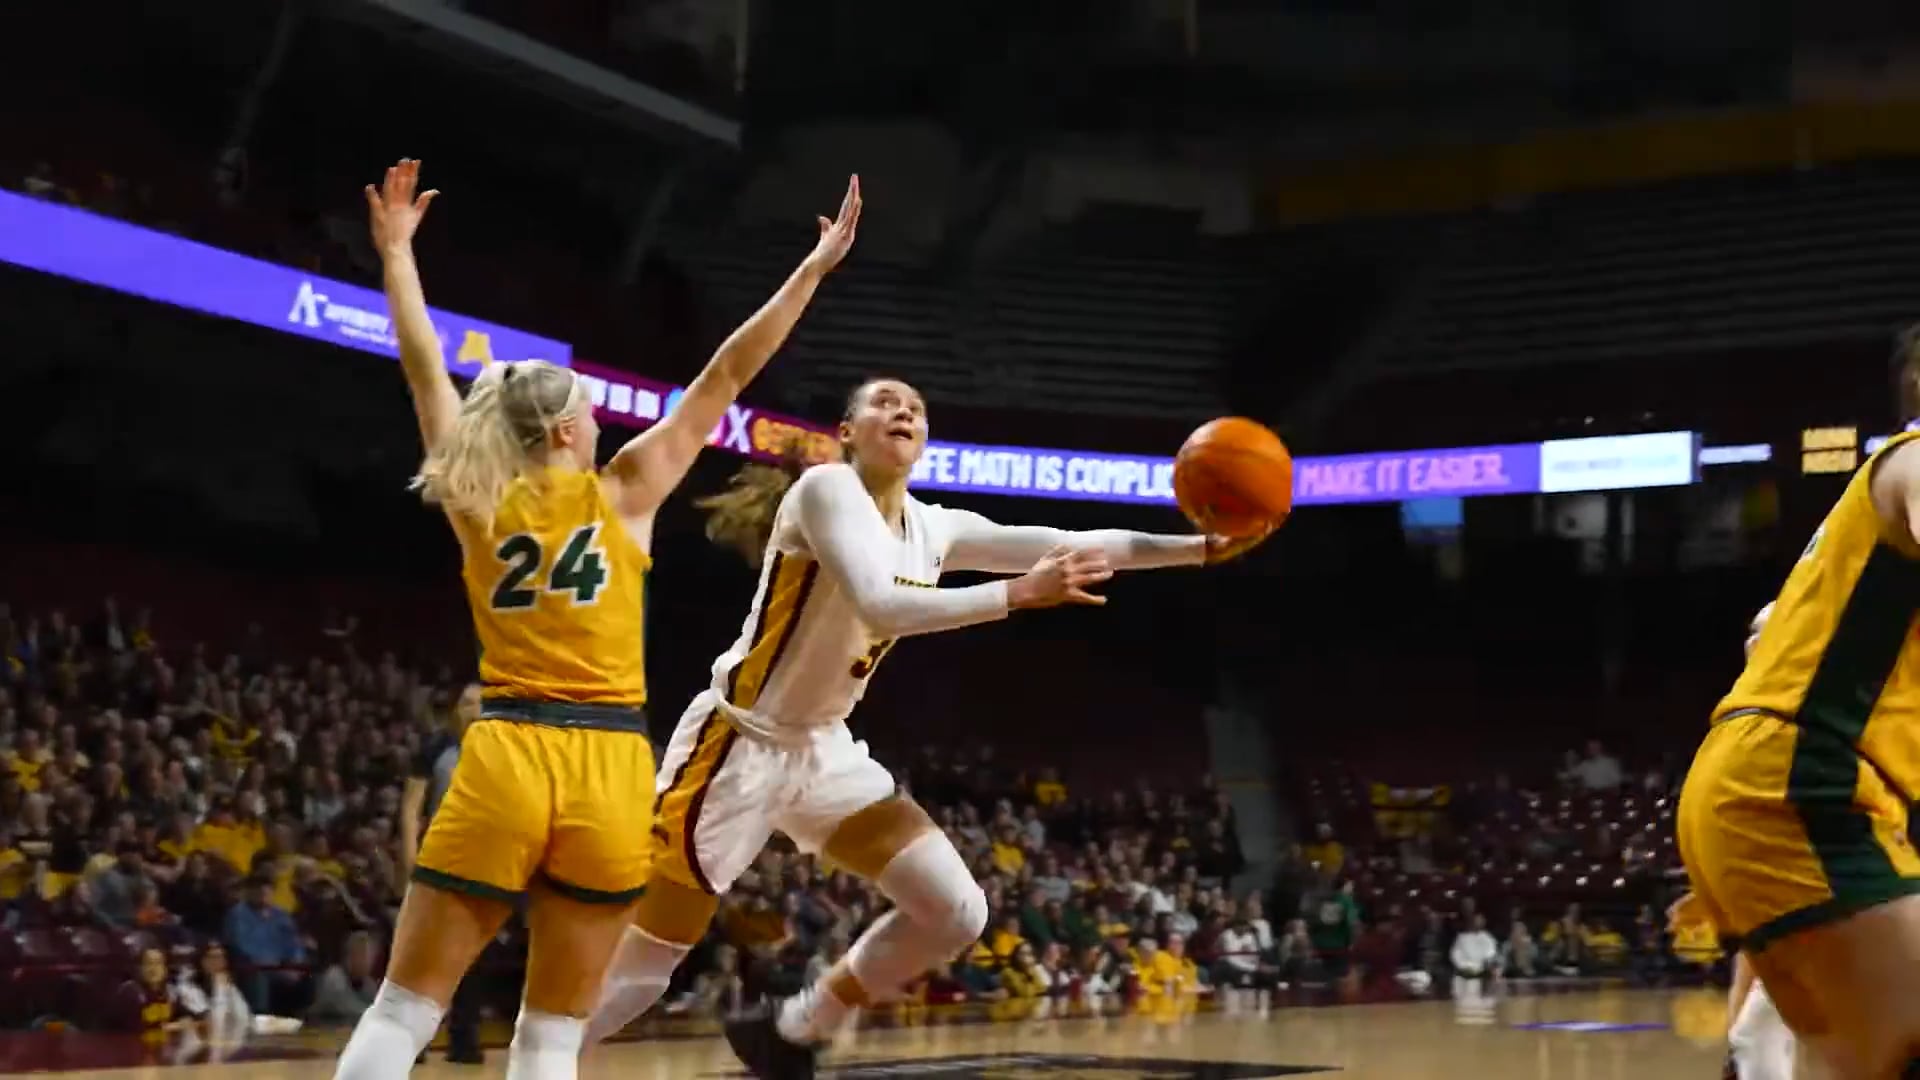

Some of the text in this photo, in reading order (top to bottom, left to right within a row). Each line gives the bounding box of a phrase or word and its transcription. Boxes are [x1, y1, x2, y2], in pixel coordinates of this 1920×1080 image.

[959, 449, 1031, 488] MATH
[1035, 454, 1064, 491] IS
[1300, 461, 1373, 497] MAKE
[1376, 458, 1404, 493] IT
[490, 523, 607, 610] 24
